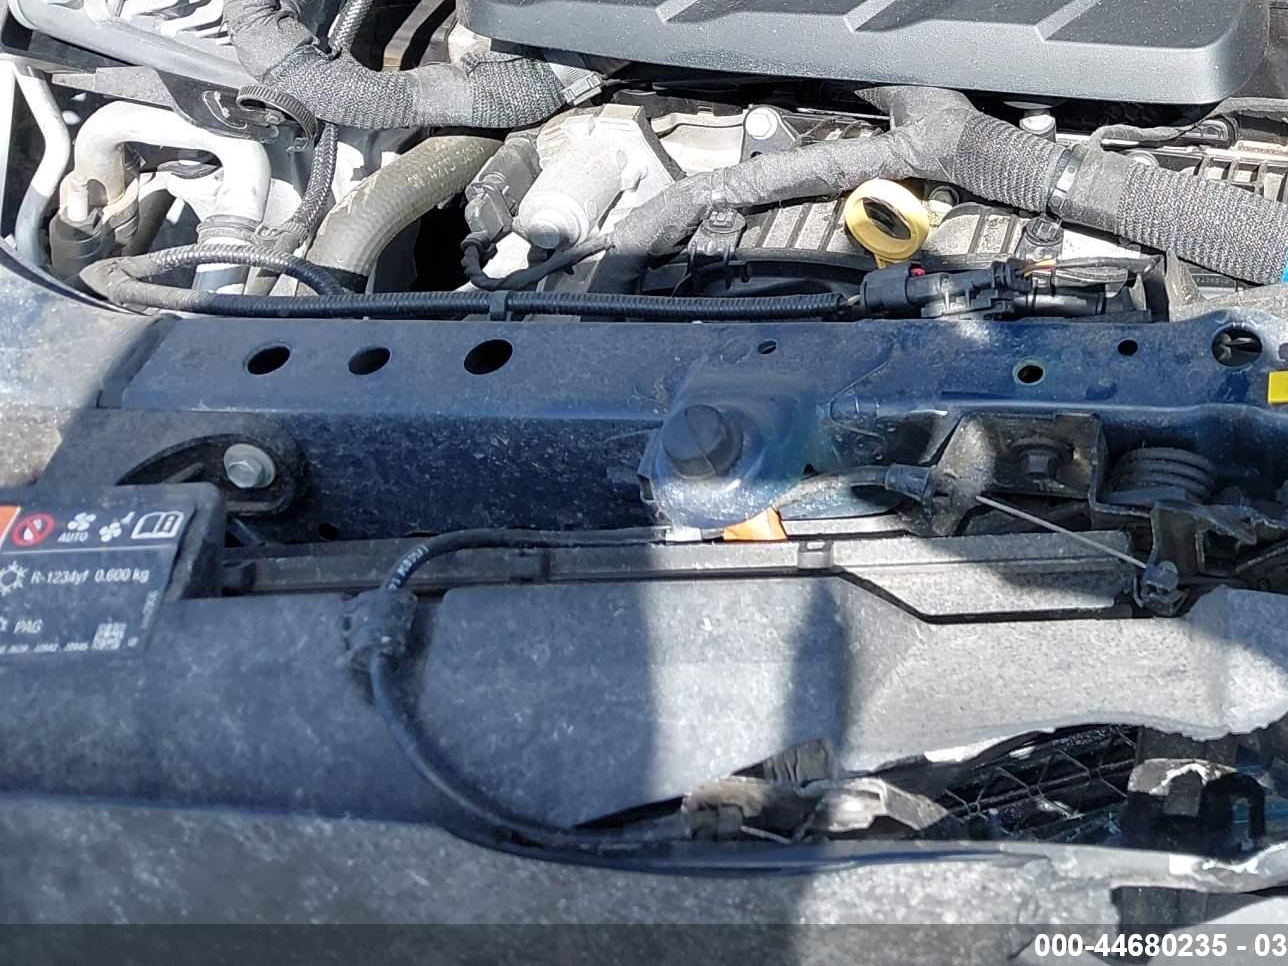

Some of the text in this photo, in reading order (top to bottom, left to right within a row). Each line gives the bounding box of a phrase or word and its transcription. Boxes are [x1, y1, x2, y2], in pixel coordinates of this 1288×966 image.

[57, 532, 89, 543] AUTO
[30, 568, 150, 585] R-1234yf 0.600 kg
[13, 619, 44, 634] PAG
